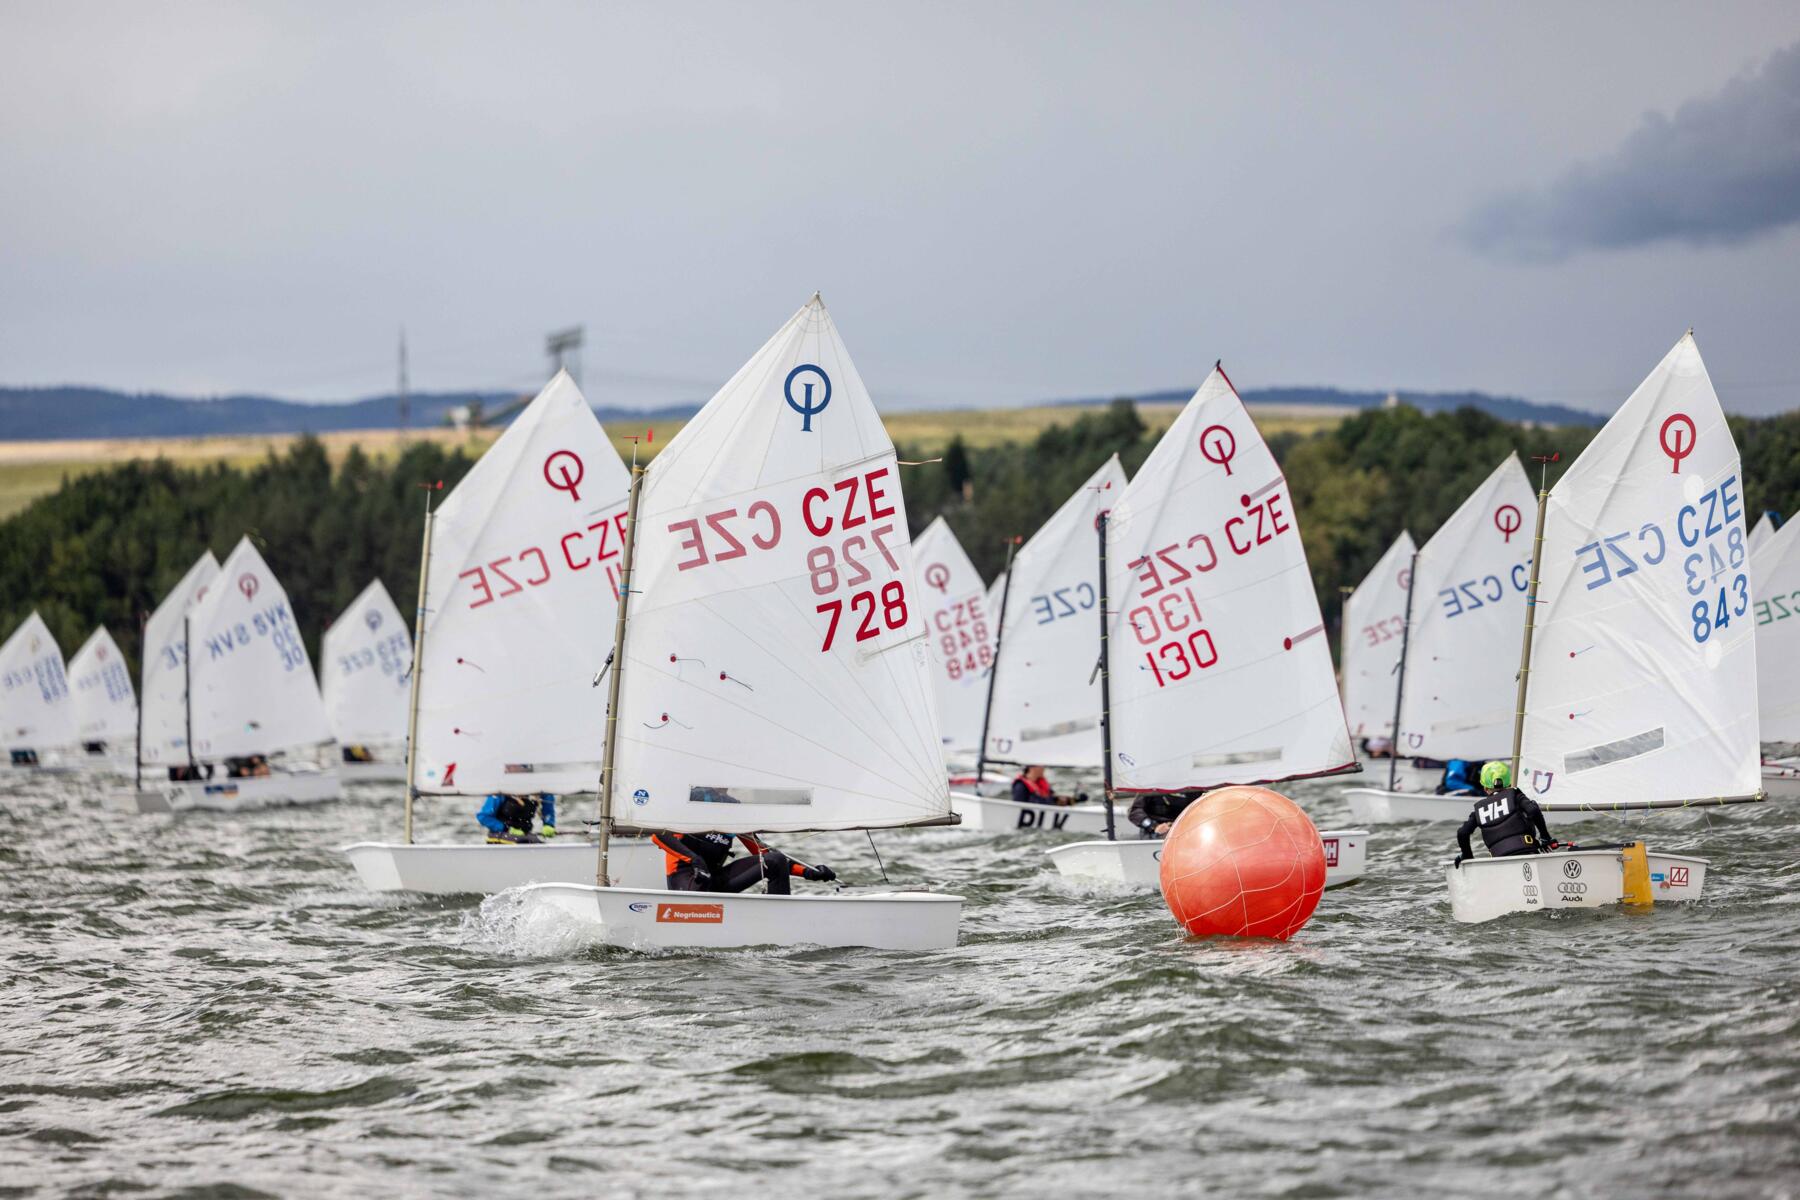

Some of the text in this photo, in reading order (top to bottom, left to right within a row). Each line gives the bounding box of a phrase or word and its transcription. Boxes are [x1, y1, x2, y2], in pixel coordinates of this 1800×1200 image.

[802, 467, 896, 537] CZE
[1225, 493, 1290, 555] CZE
[1677, 475, 1742, 547] CZE
[815, 580, 909, 652] 728
[934, 595, 985, 633] CZE
[1691, 573, 1748, 643] 843
[946, 644, 993, 681] 848
[1145, 629, 1219, 688] 130
